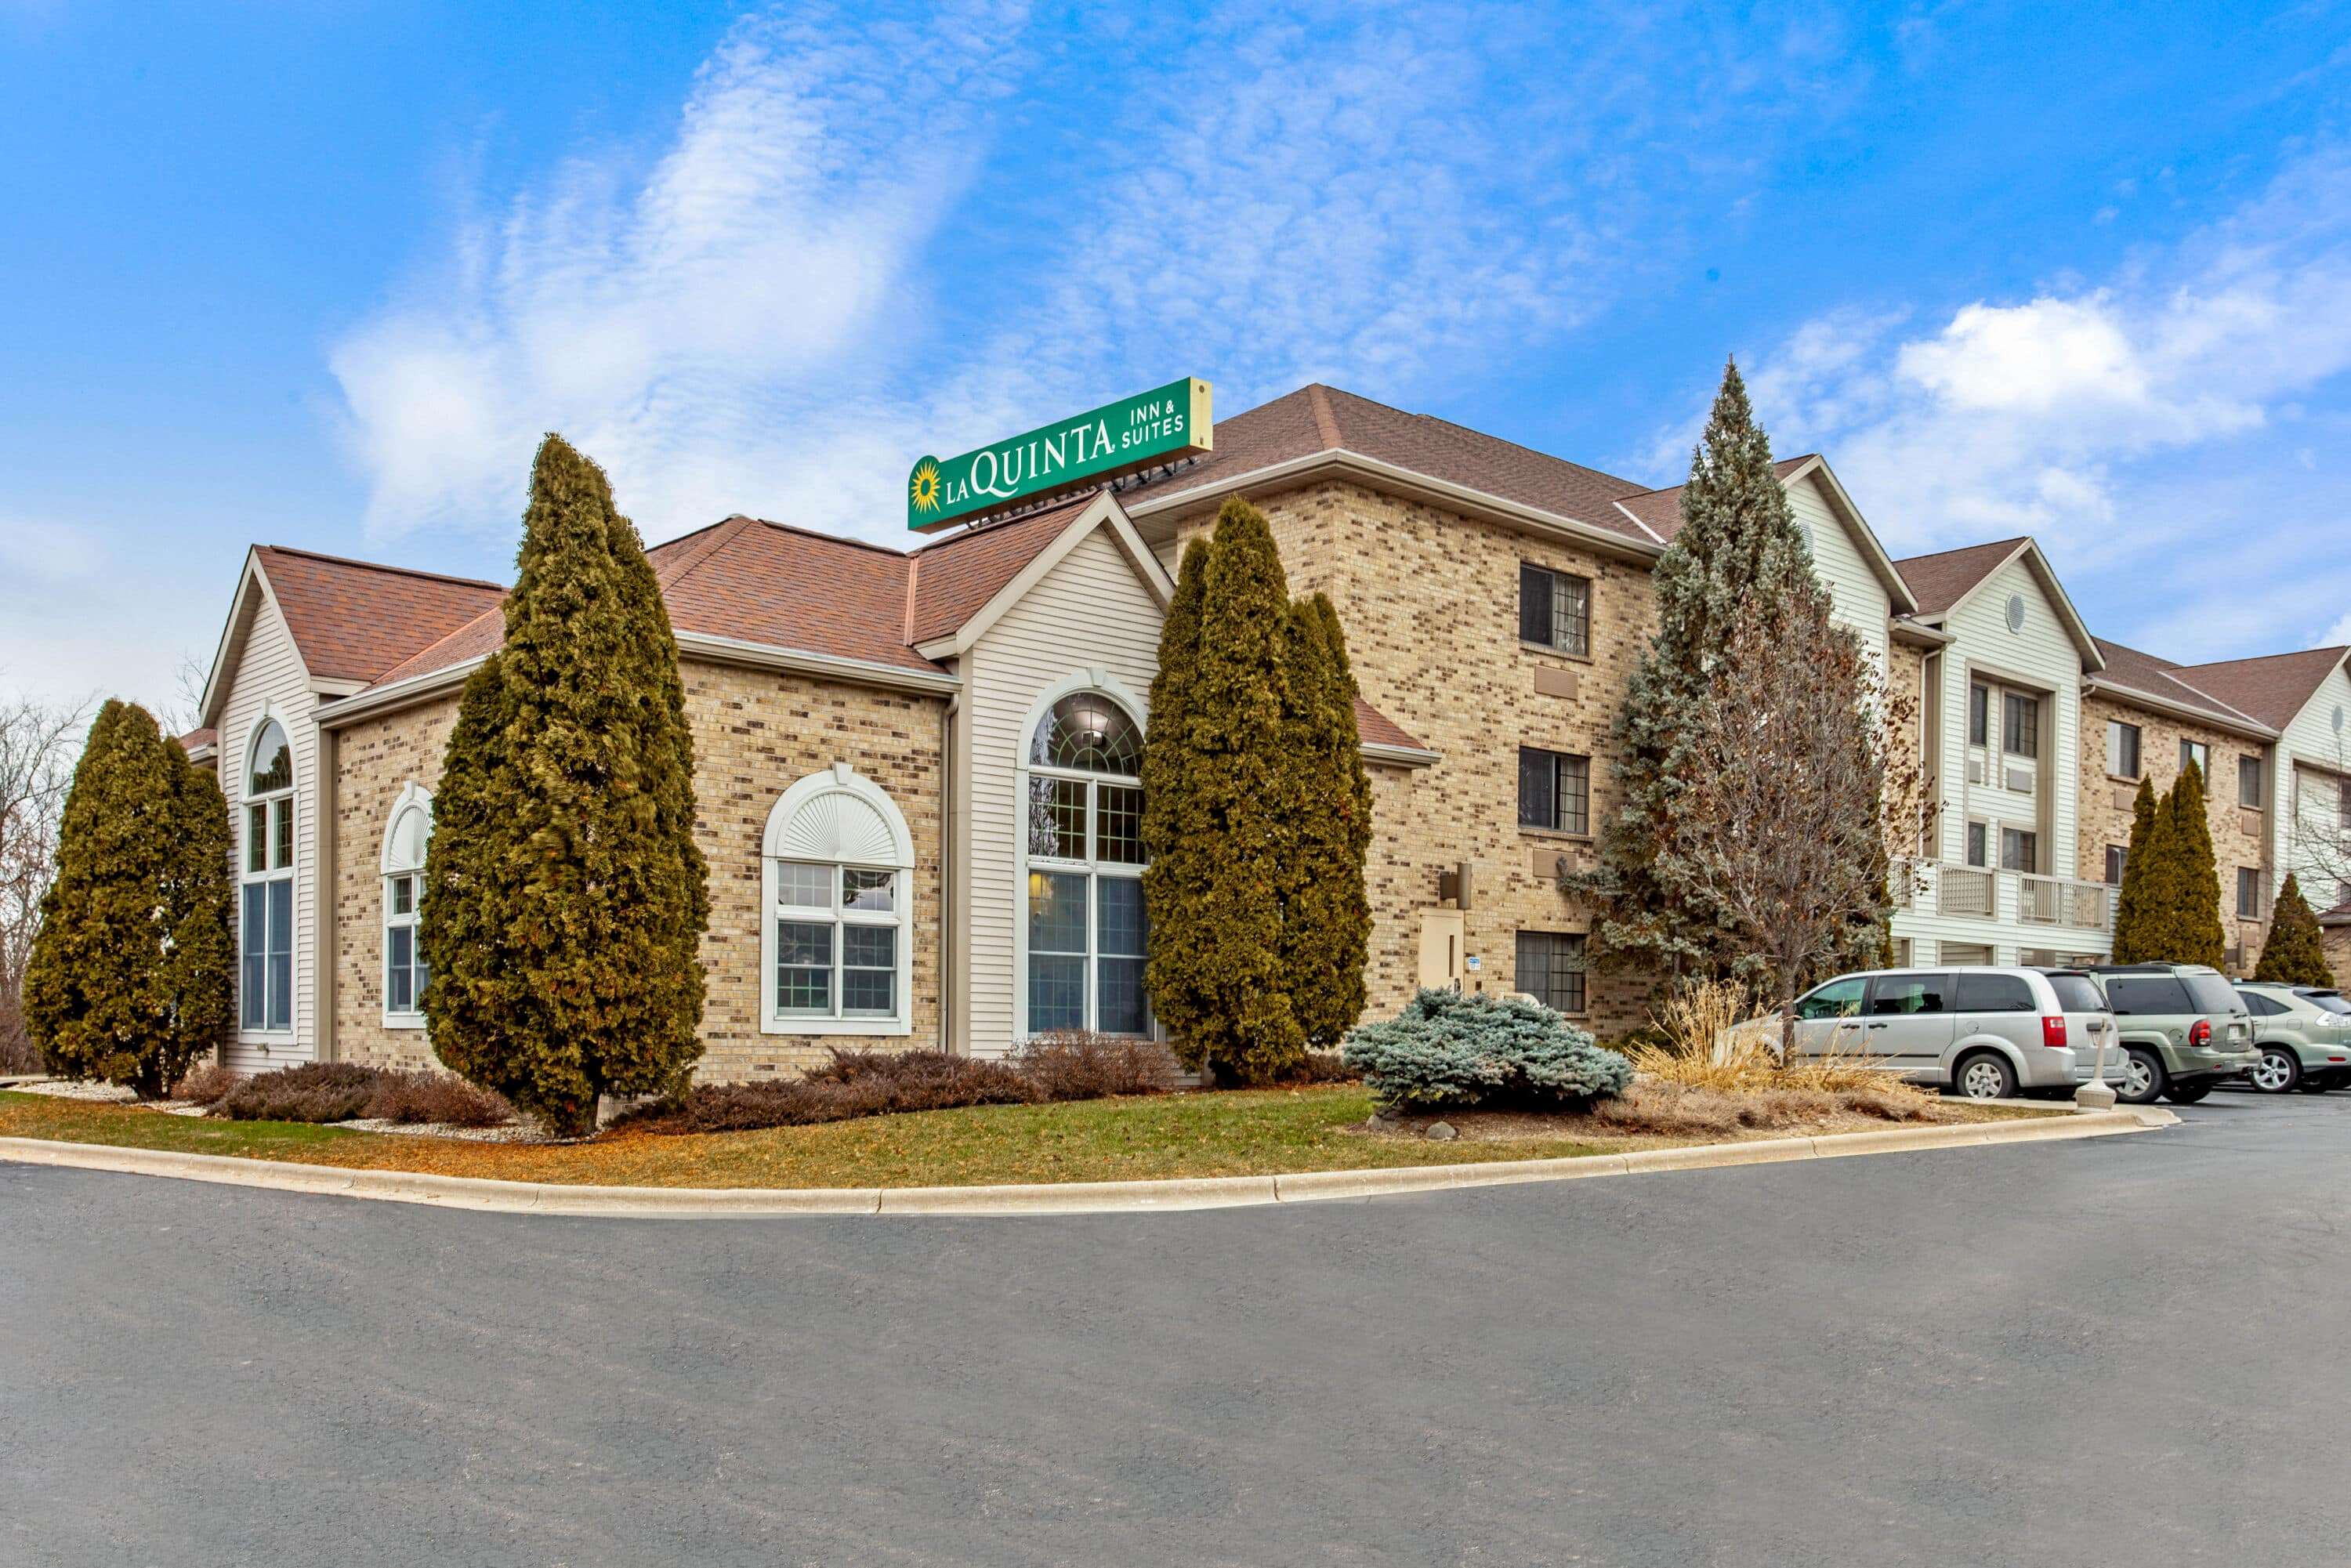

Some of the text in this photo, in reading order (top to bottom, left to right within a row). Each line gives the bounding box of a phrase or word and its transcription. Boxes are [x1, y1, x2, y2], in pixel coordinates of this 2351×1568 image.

[1131, 400, 1174, 426] INN &
[1121, 414, 1183, 449] SUITES
[947, 419, 1114, 505] LA QUINTA
